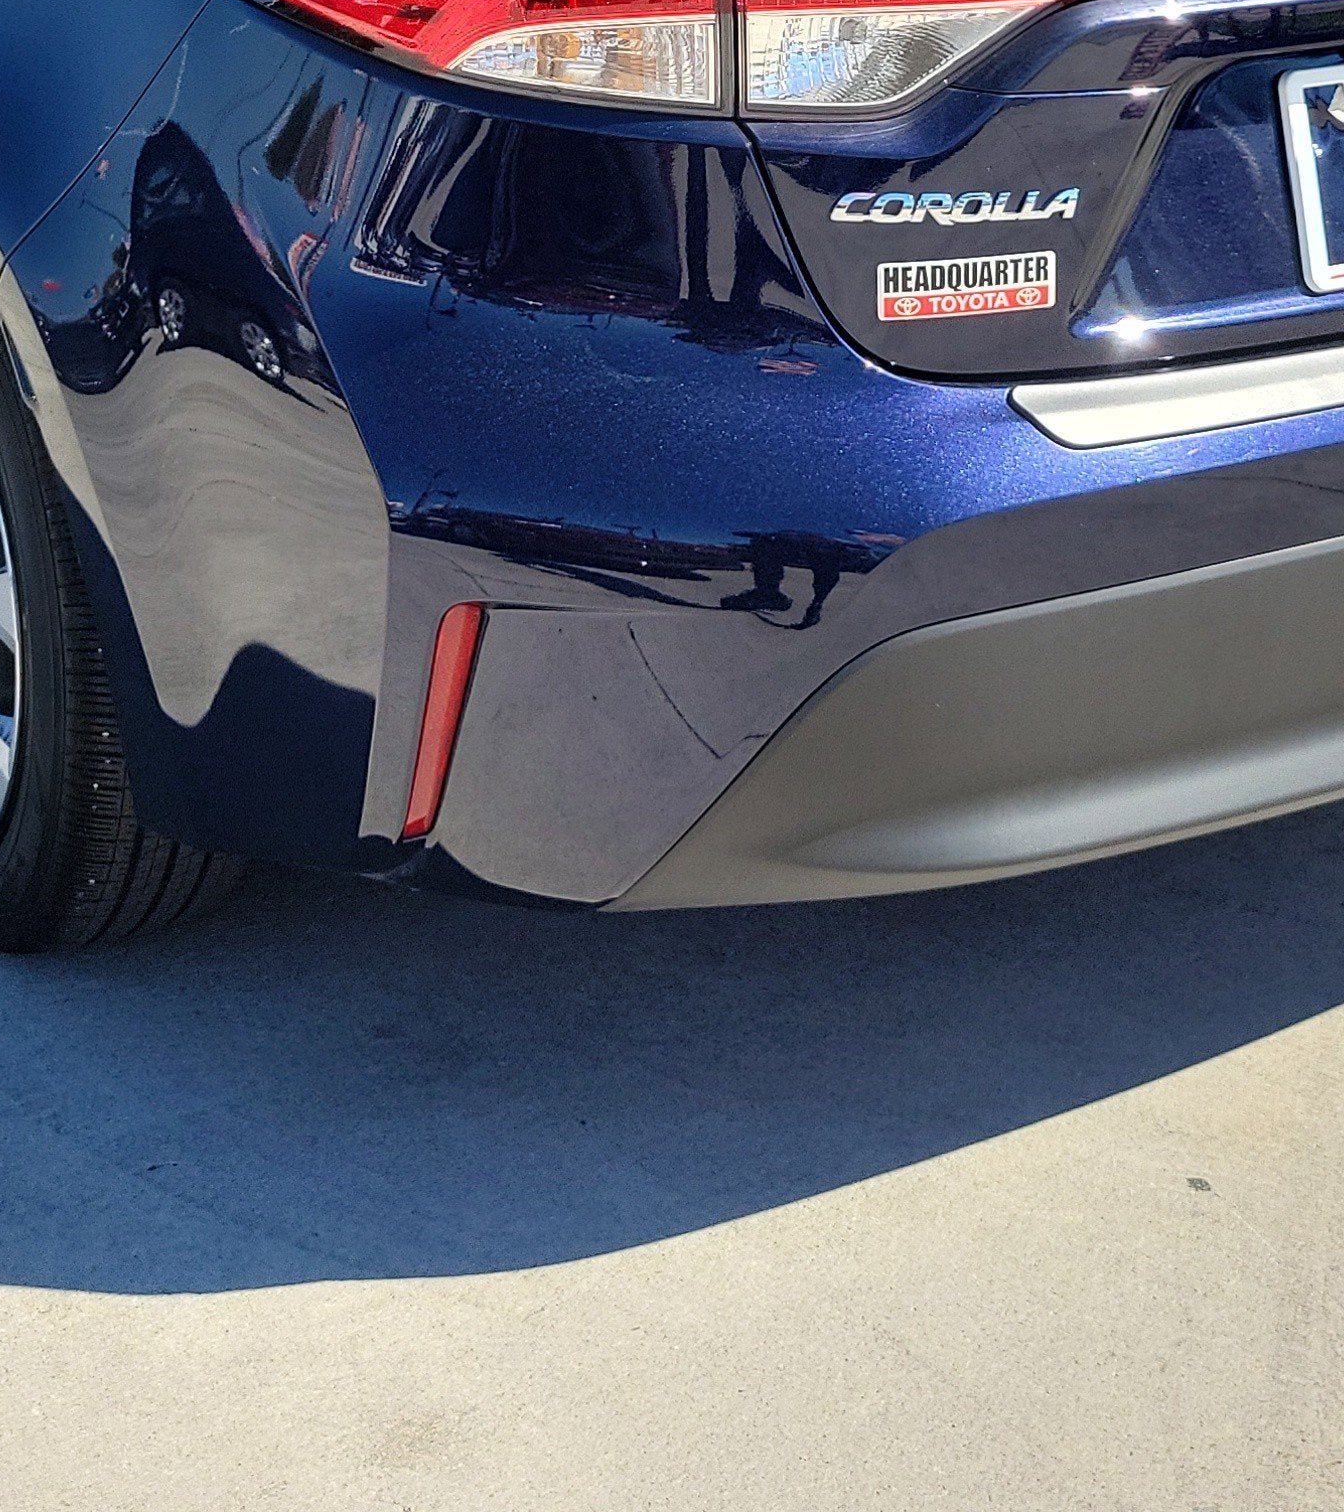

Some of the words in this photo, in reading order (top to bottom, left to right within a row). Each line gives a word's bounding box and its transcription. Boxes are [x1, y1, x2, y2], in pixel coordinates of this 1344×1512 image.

[830, 187, 1080, 226] COROLLA
[883, 255, 1049, 292] HEADQUARTER
[928, 291, 1009, 313] TOYOTA
